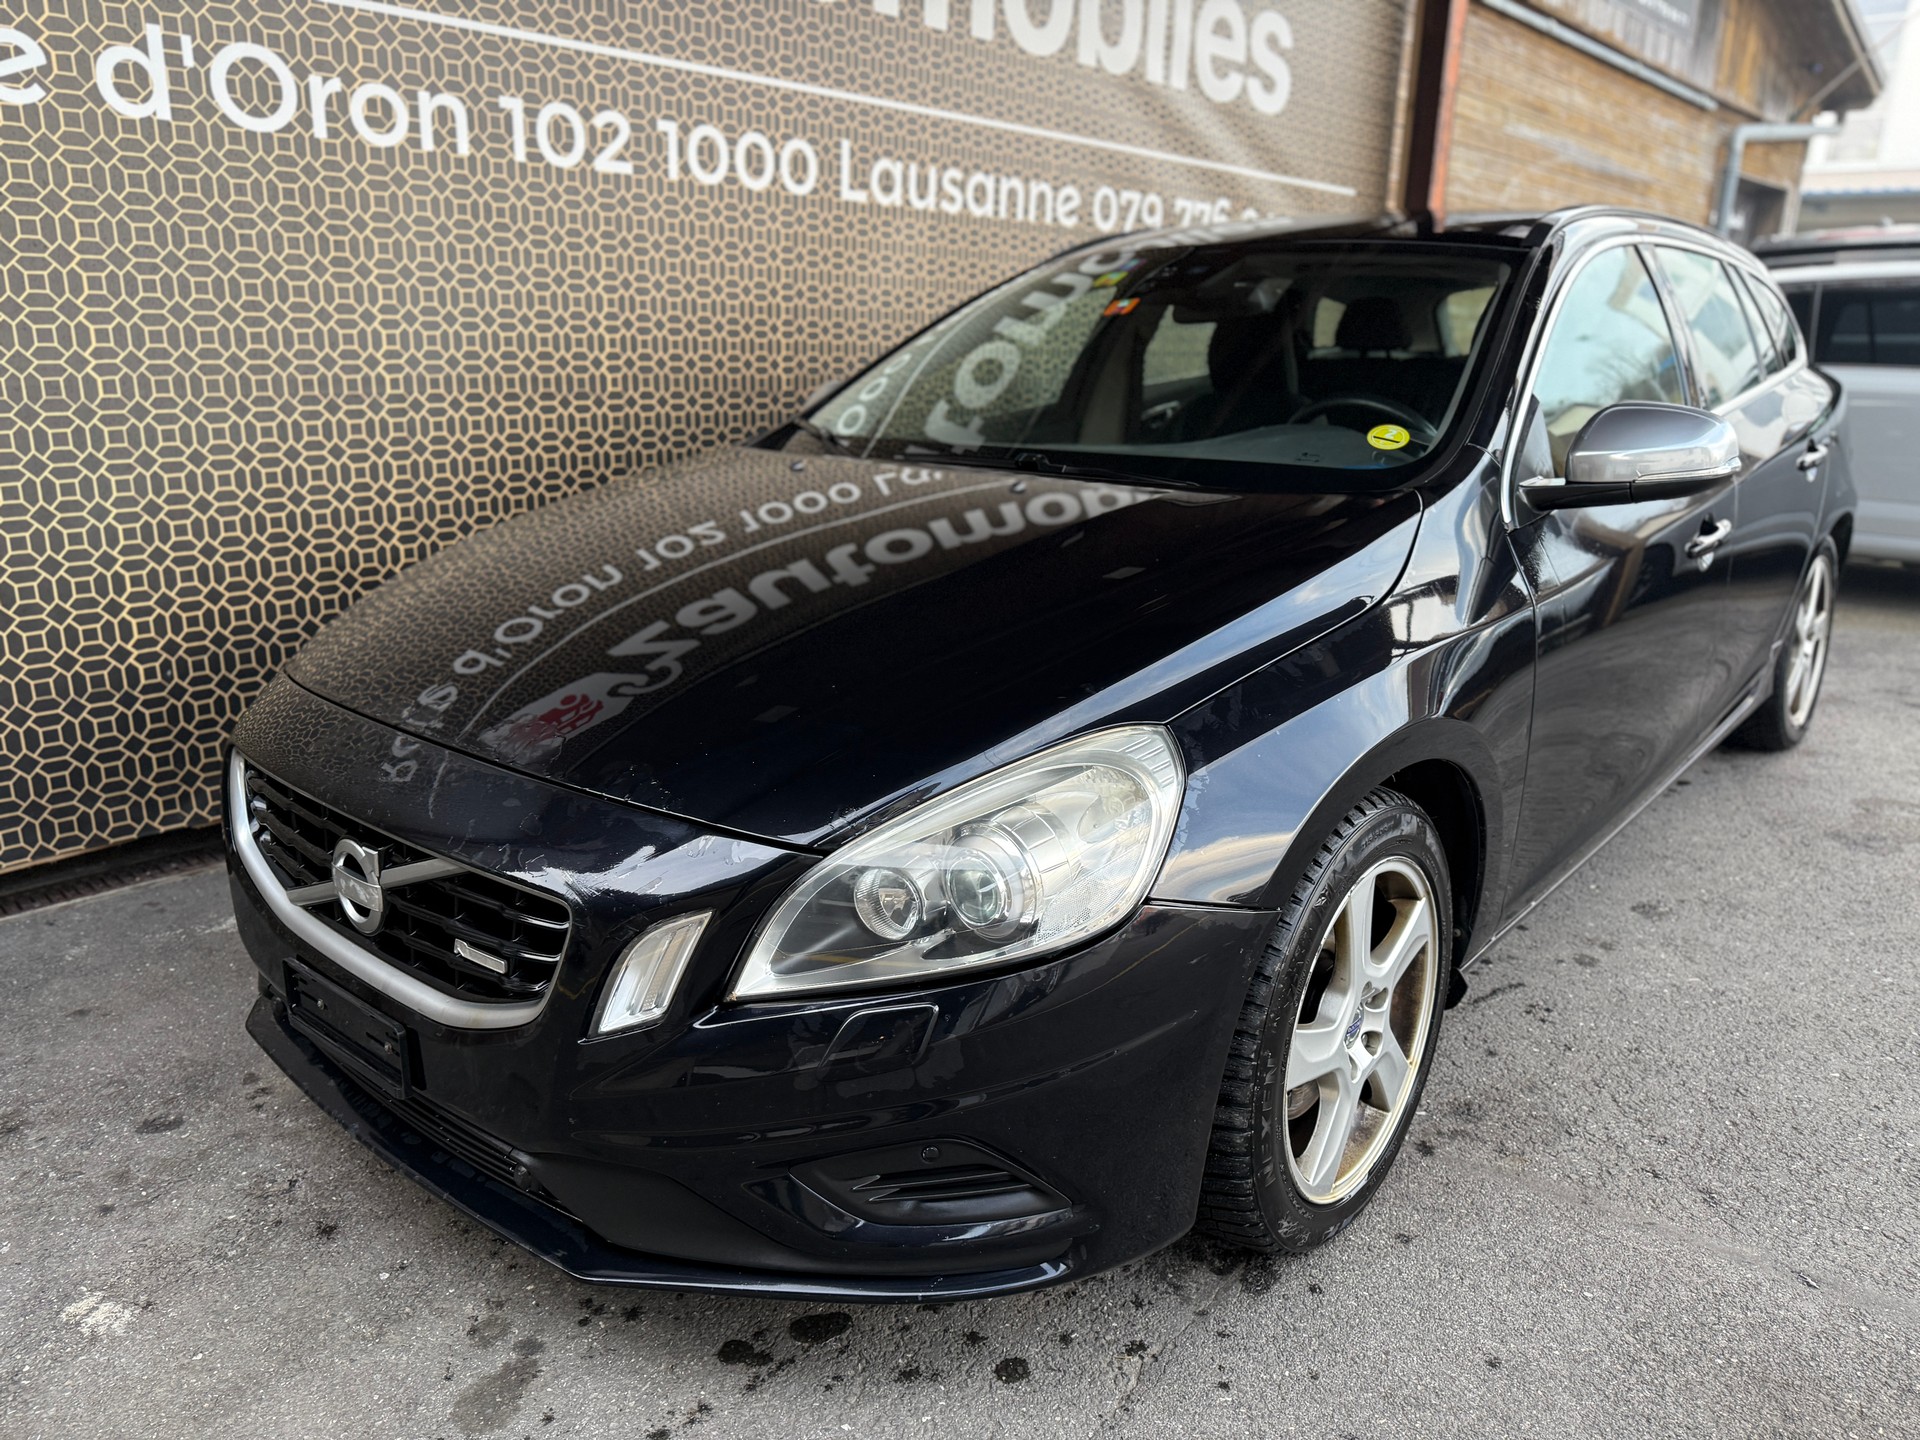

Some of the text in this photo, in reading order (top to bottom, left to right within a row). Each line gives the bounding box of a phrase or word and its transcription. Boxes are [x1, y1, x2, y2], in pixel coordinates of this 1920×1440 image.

[95, 23, 470, 156] d'Oron
[499, 95, 634, 175] 102
[656, 119, 818, 196] 1000
[841, 139, 1080, 228] Lausanne
[1093, 185, 1164, 234] 079
[1260, 1058, 1278, 1187] NEXEN
